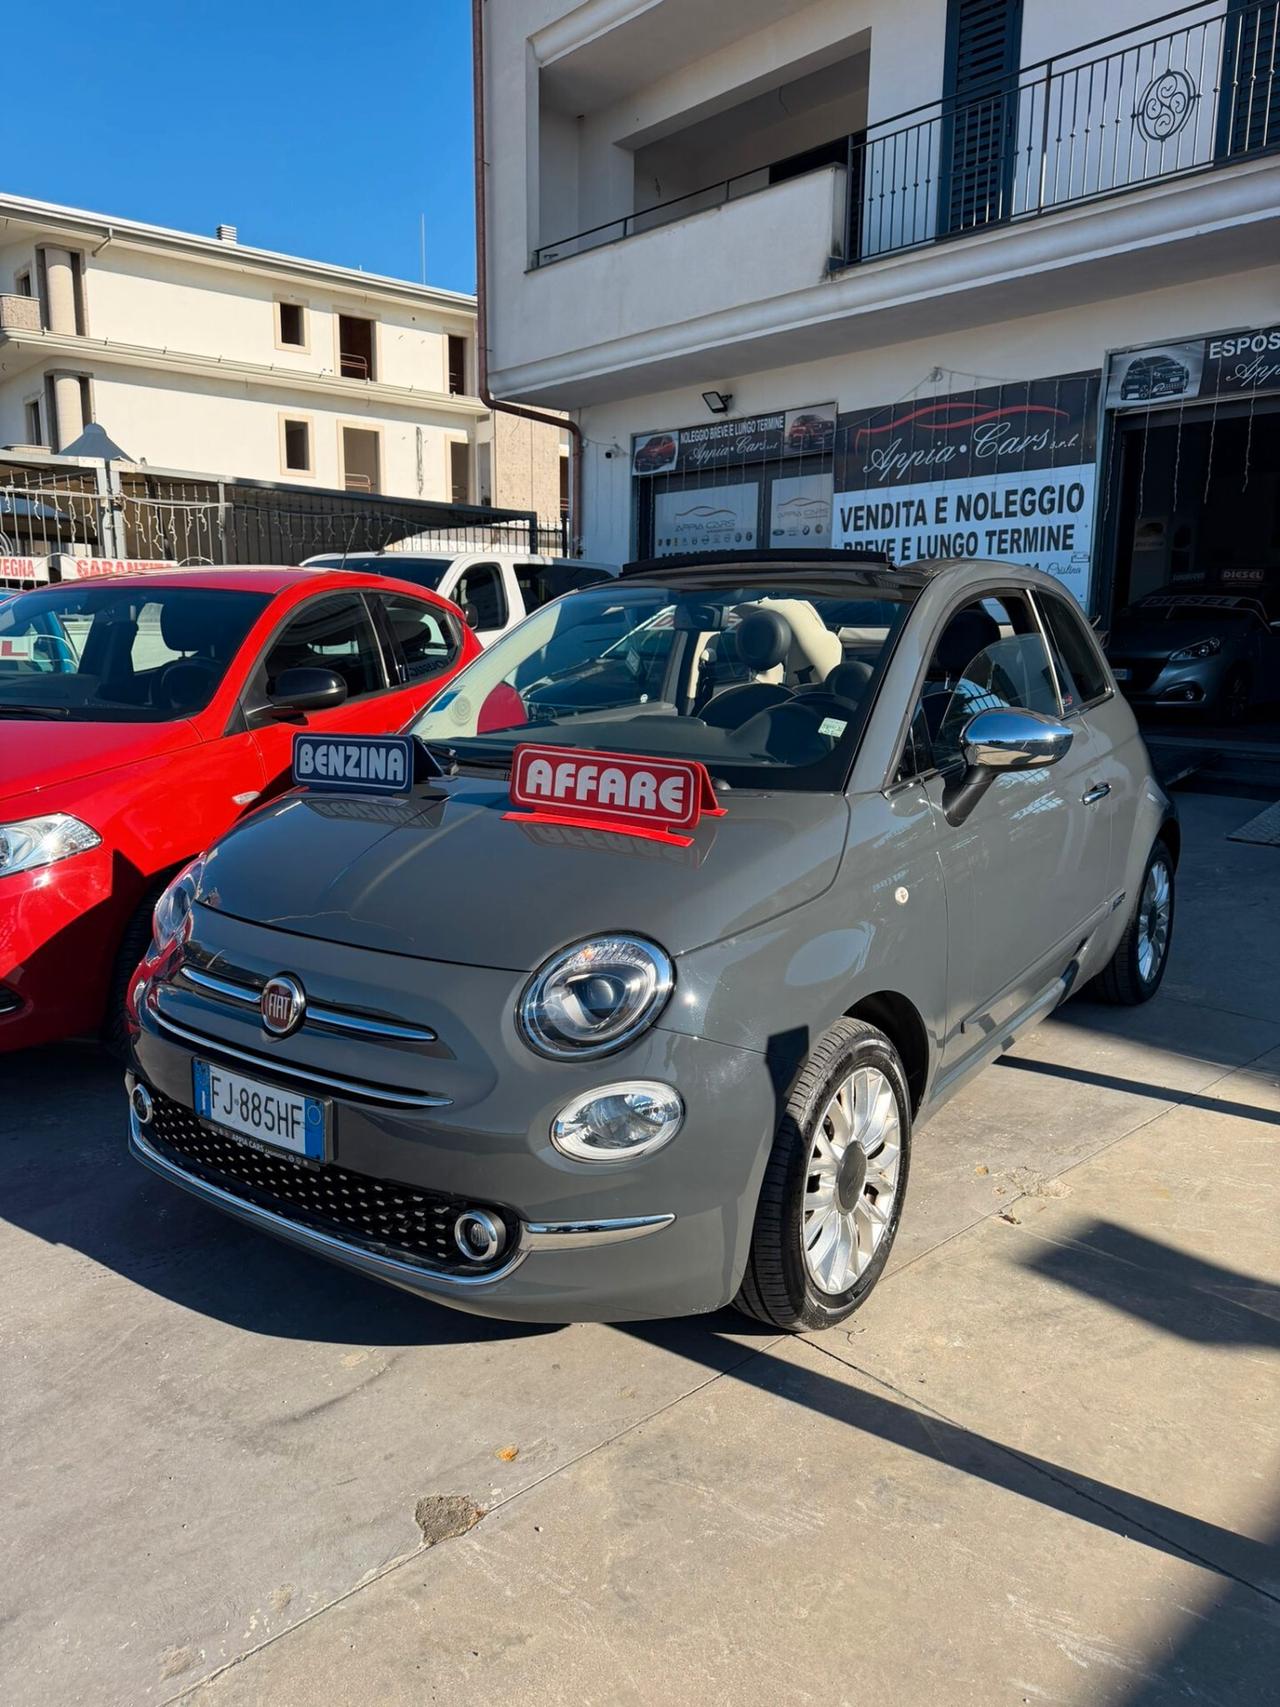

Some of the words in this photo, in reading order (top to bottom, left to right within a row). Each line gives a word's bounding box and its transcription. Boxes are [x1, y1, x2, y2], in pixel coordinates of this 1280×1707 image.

[1209, 332, 1280, 359] ESPOS
[680, 428, 709, 444] NOLEGGIO
[710, 425, 728, 440] BREVE
[729, 424, 734, 437] E
[735, 420, 756, 436] LUNGO
[757, 416, 784, 431] TERMINE
[689, 443, 729, 465] Appia
[736, 435, 766, 454] Cars
[863, 438, 956, 482] Appia
[973, 422, 1050, 458] Cars
[840, 499, 927, 533] VENDITA
[935, 497, 948, 524] E
[956, 482, 1085, 523] NOLEGGIO
[901, 537, 911, 561] E
[917, 531, 979, 560] LUNGO
[985, 524, 1075, 555] TERMINE
[0, 558, 36, 577] EGNA
[1223, 570, 1262, 578] DIESEL
[299, 743, 404, 781] BENZINA
[525, 759, 684, 814] AFFARE
[268, 992, 291, 1020] FIAT
[239, 1087, 303, 1140] 885HF
